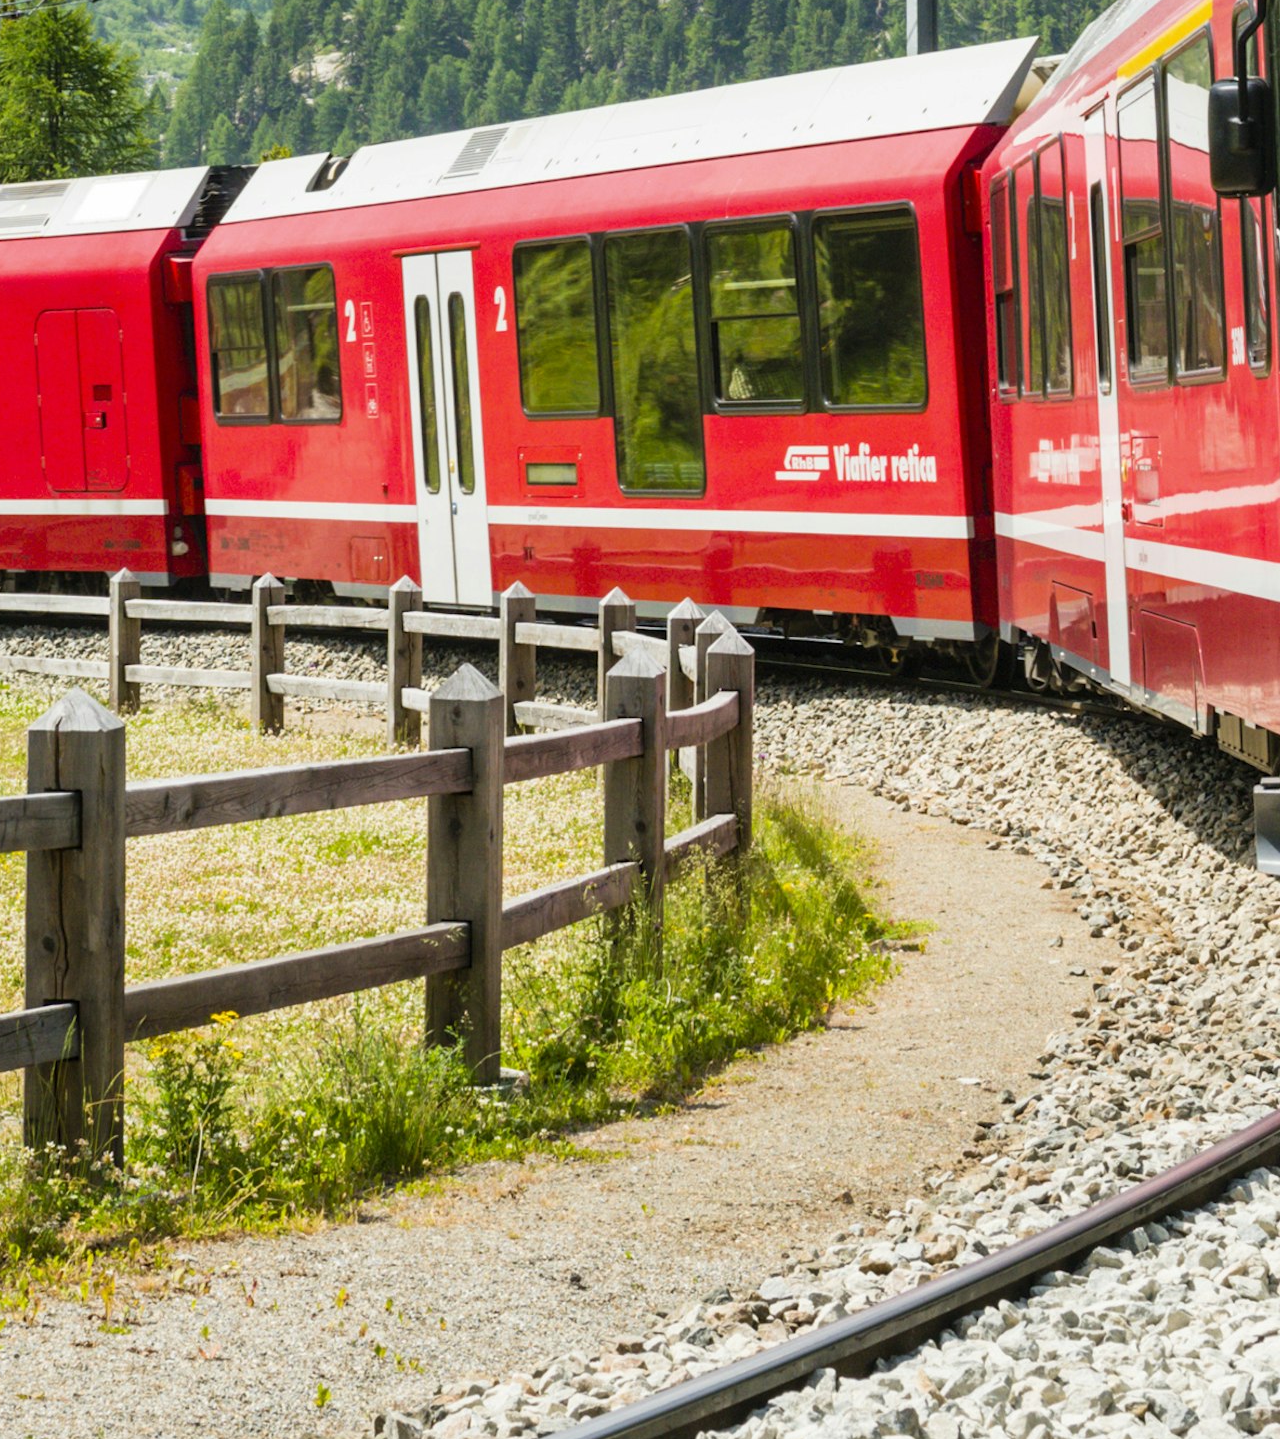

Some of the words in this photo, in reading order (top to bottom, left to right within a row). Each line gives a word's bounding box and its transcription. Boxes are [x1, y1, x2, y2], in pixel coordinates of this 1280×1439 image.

[344, 299, 357, 343] 2
[494, 286, 508, 332] 2
[832, 441, 888, 482] Viafier
[890, 442, 937, 483] retica
